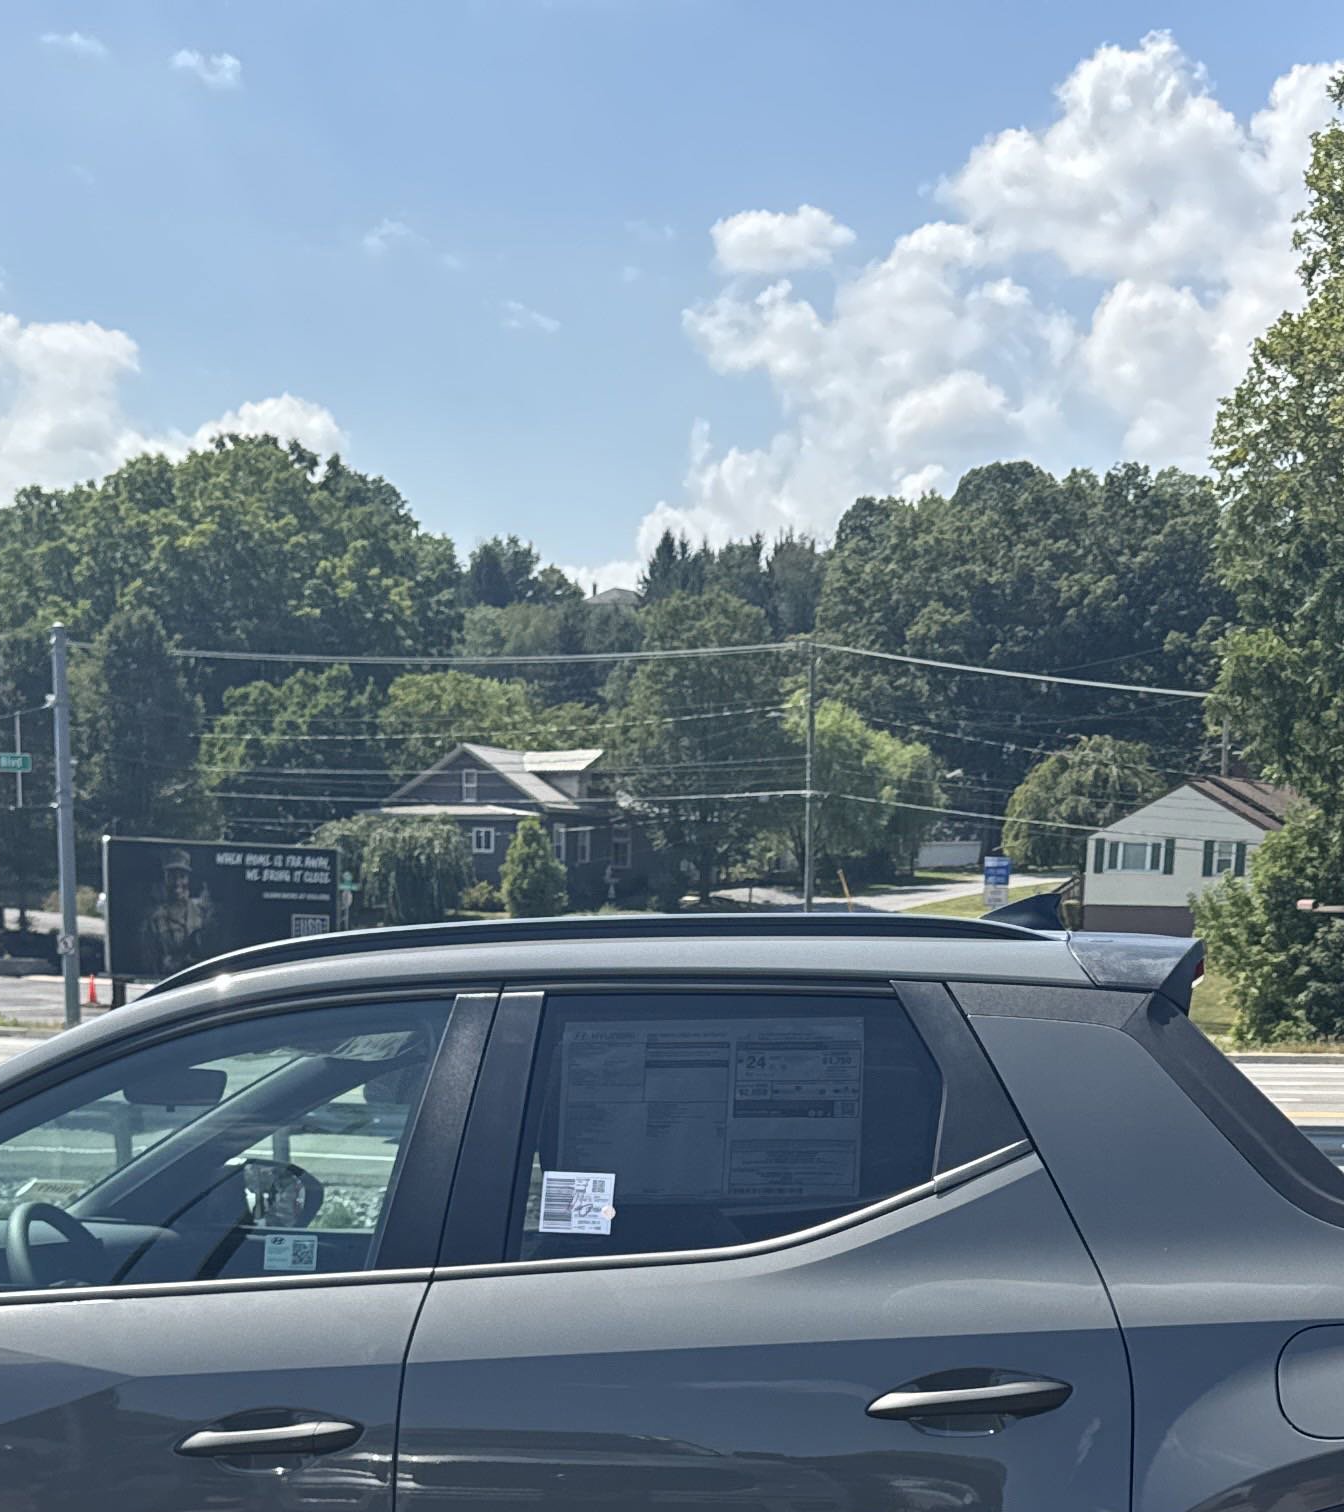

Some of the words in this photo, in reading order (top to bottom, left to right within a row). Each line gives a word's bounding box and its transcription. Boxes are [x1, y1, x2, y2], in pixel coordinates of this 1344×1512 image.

[216, 852, 243, 865] WHEN
[244, 853, 273, 866] HOME
[261, 869, 291, 882] BRING
[292, 870, 303, 883] IT
